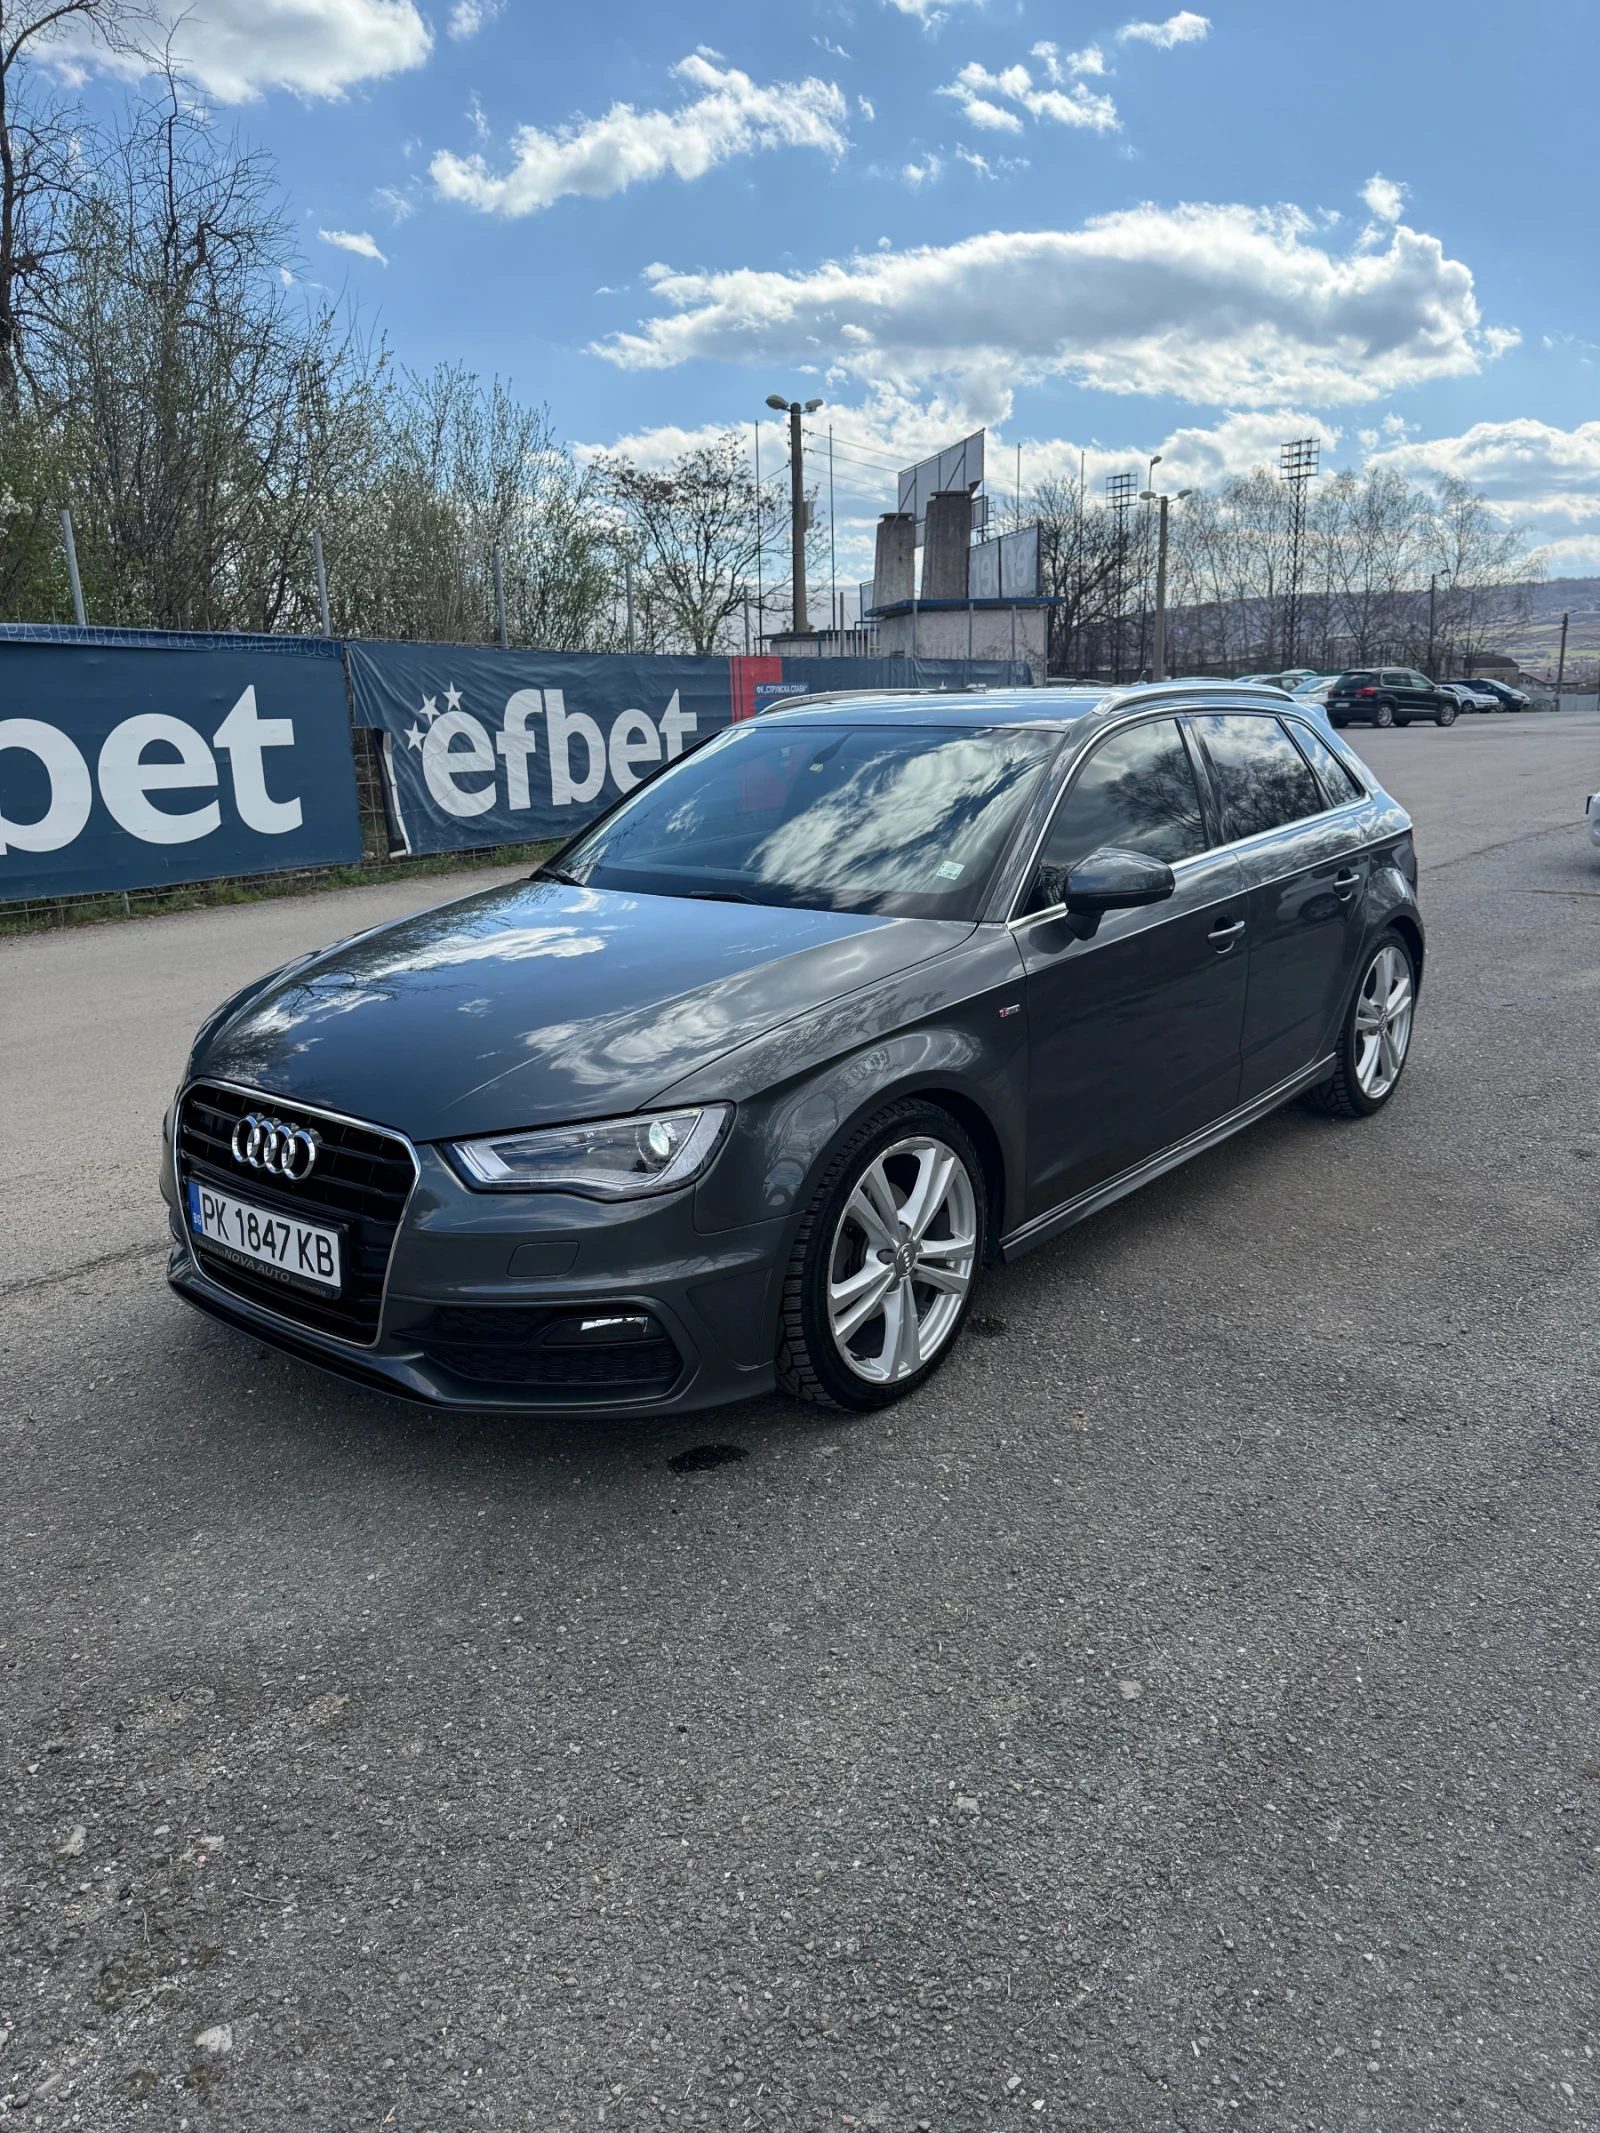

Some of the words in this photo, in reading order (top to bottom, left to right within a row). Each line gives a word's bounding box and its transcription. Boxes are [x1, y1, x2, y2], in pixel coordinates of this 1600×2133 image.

[4, 623, 157, 646] РАЗВИВАНЕ
[166, 631, 196, 648] НА
[422, 688, 697, 817] efbet
[193, 1212, 202, 1226] BG
[202, 1193, 230, 1241] PK
[235, 1208, 290, 1262] 1847
[297, 1228, 334, 1277] KB
[224, 1250, 255, 1270] NOVA
[256, 1264, 290, 1283] AUTO
